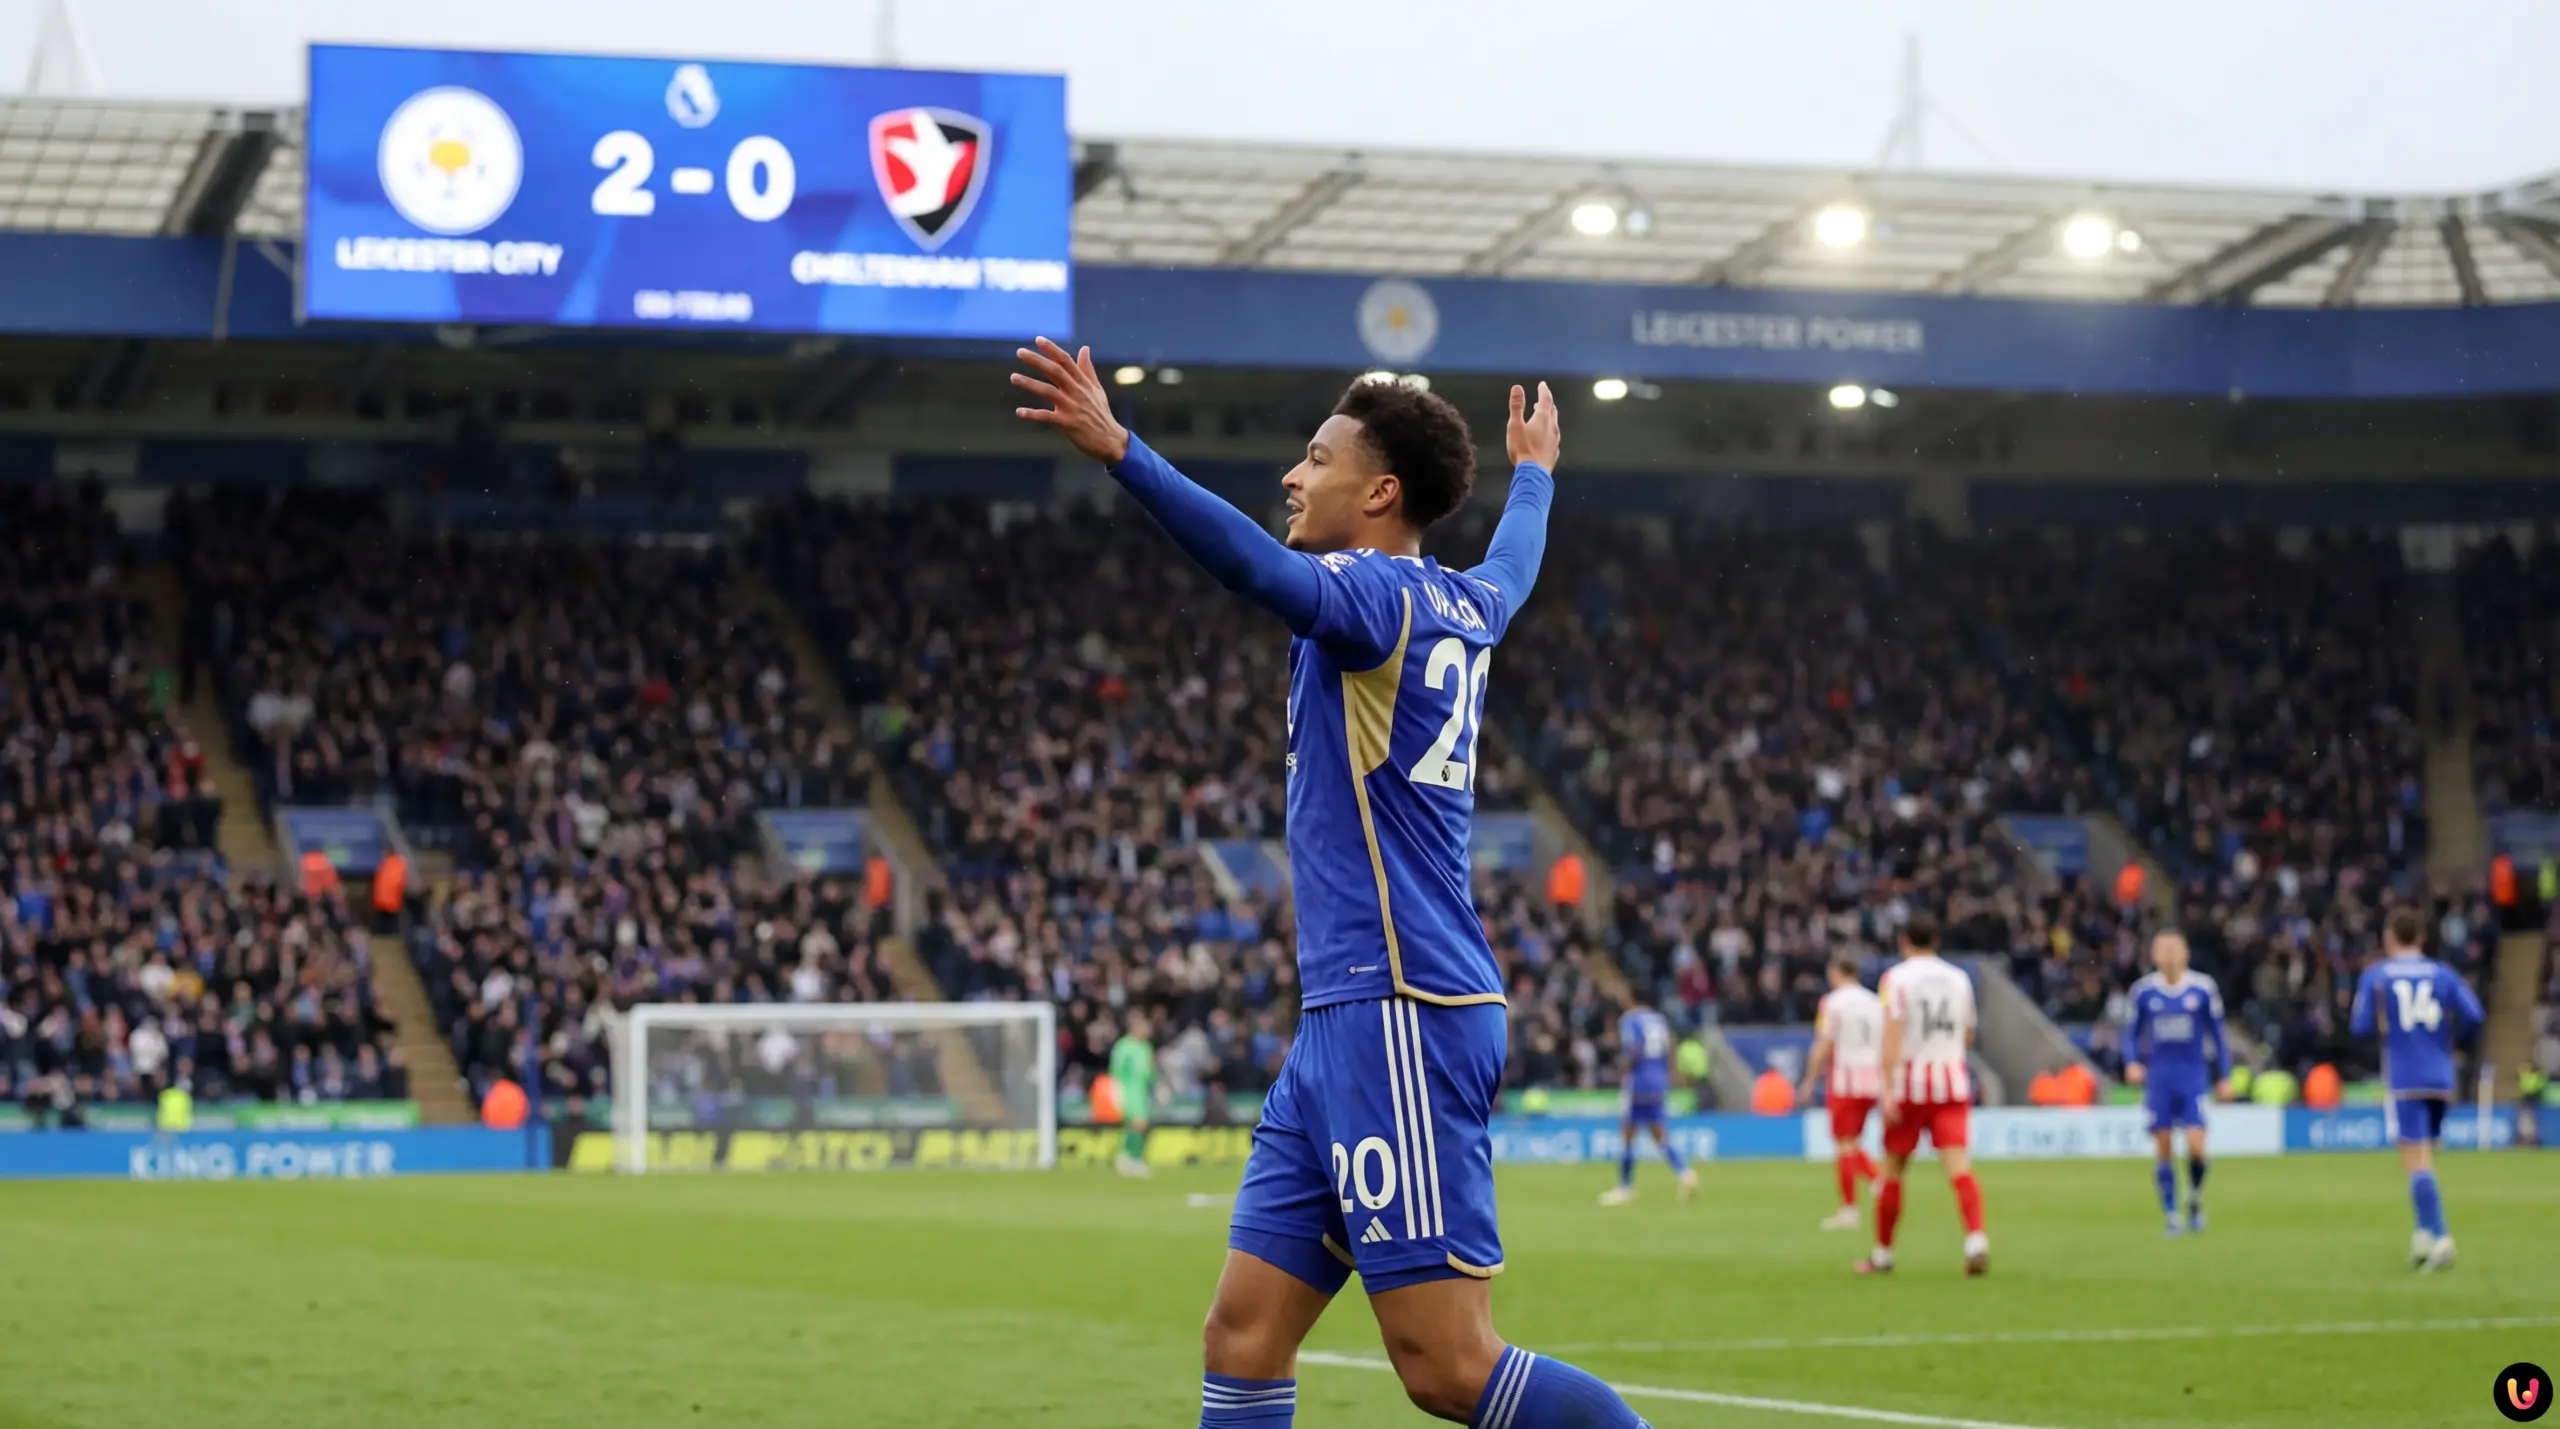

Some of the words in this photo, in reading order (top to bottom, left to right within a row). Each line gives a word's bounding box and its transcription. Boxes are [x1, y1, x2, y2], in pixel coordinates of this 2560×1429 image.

[335, 236, 491, 274] LEICESTER
[492, 241, 563, 276] CITY
[129, 1143, 237, 1181] KING
[246, 1140, 395, 1179] POWER
[1331, 1136, 1397, 1213] 20
